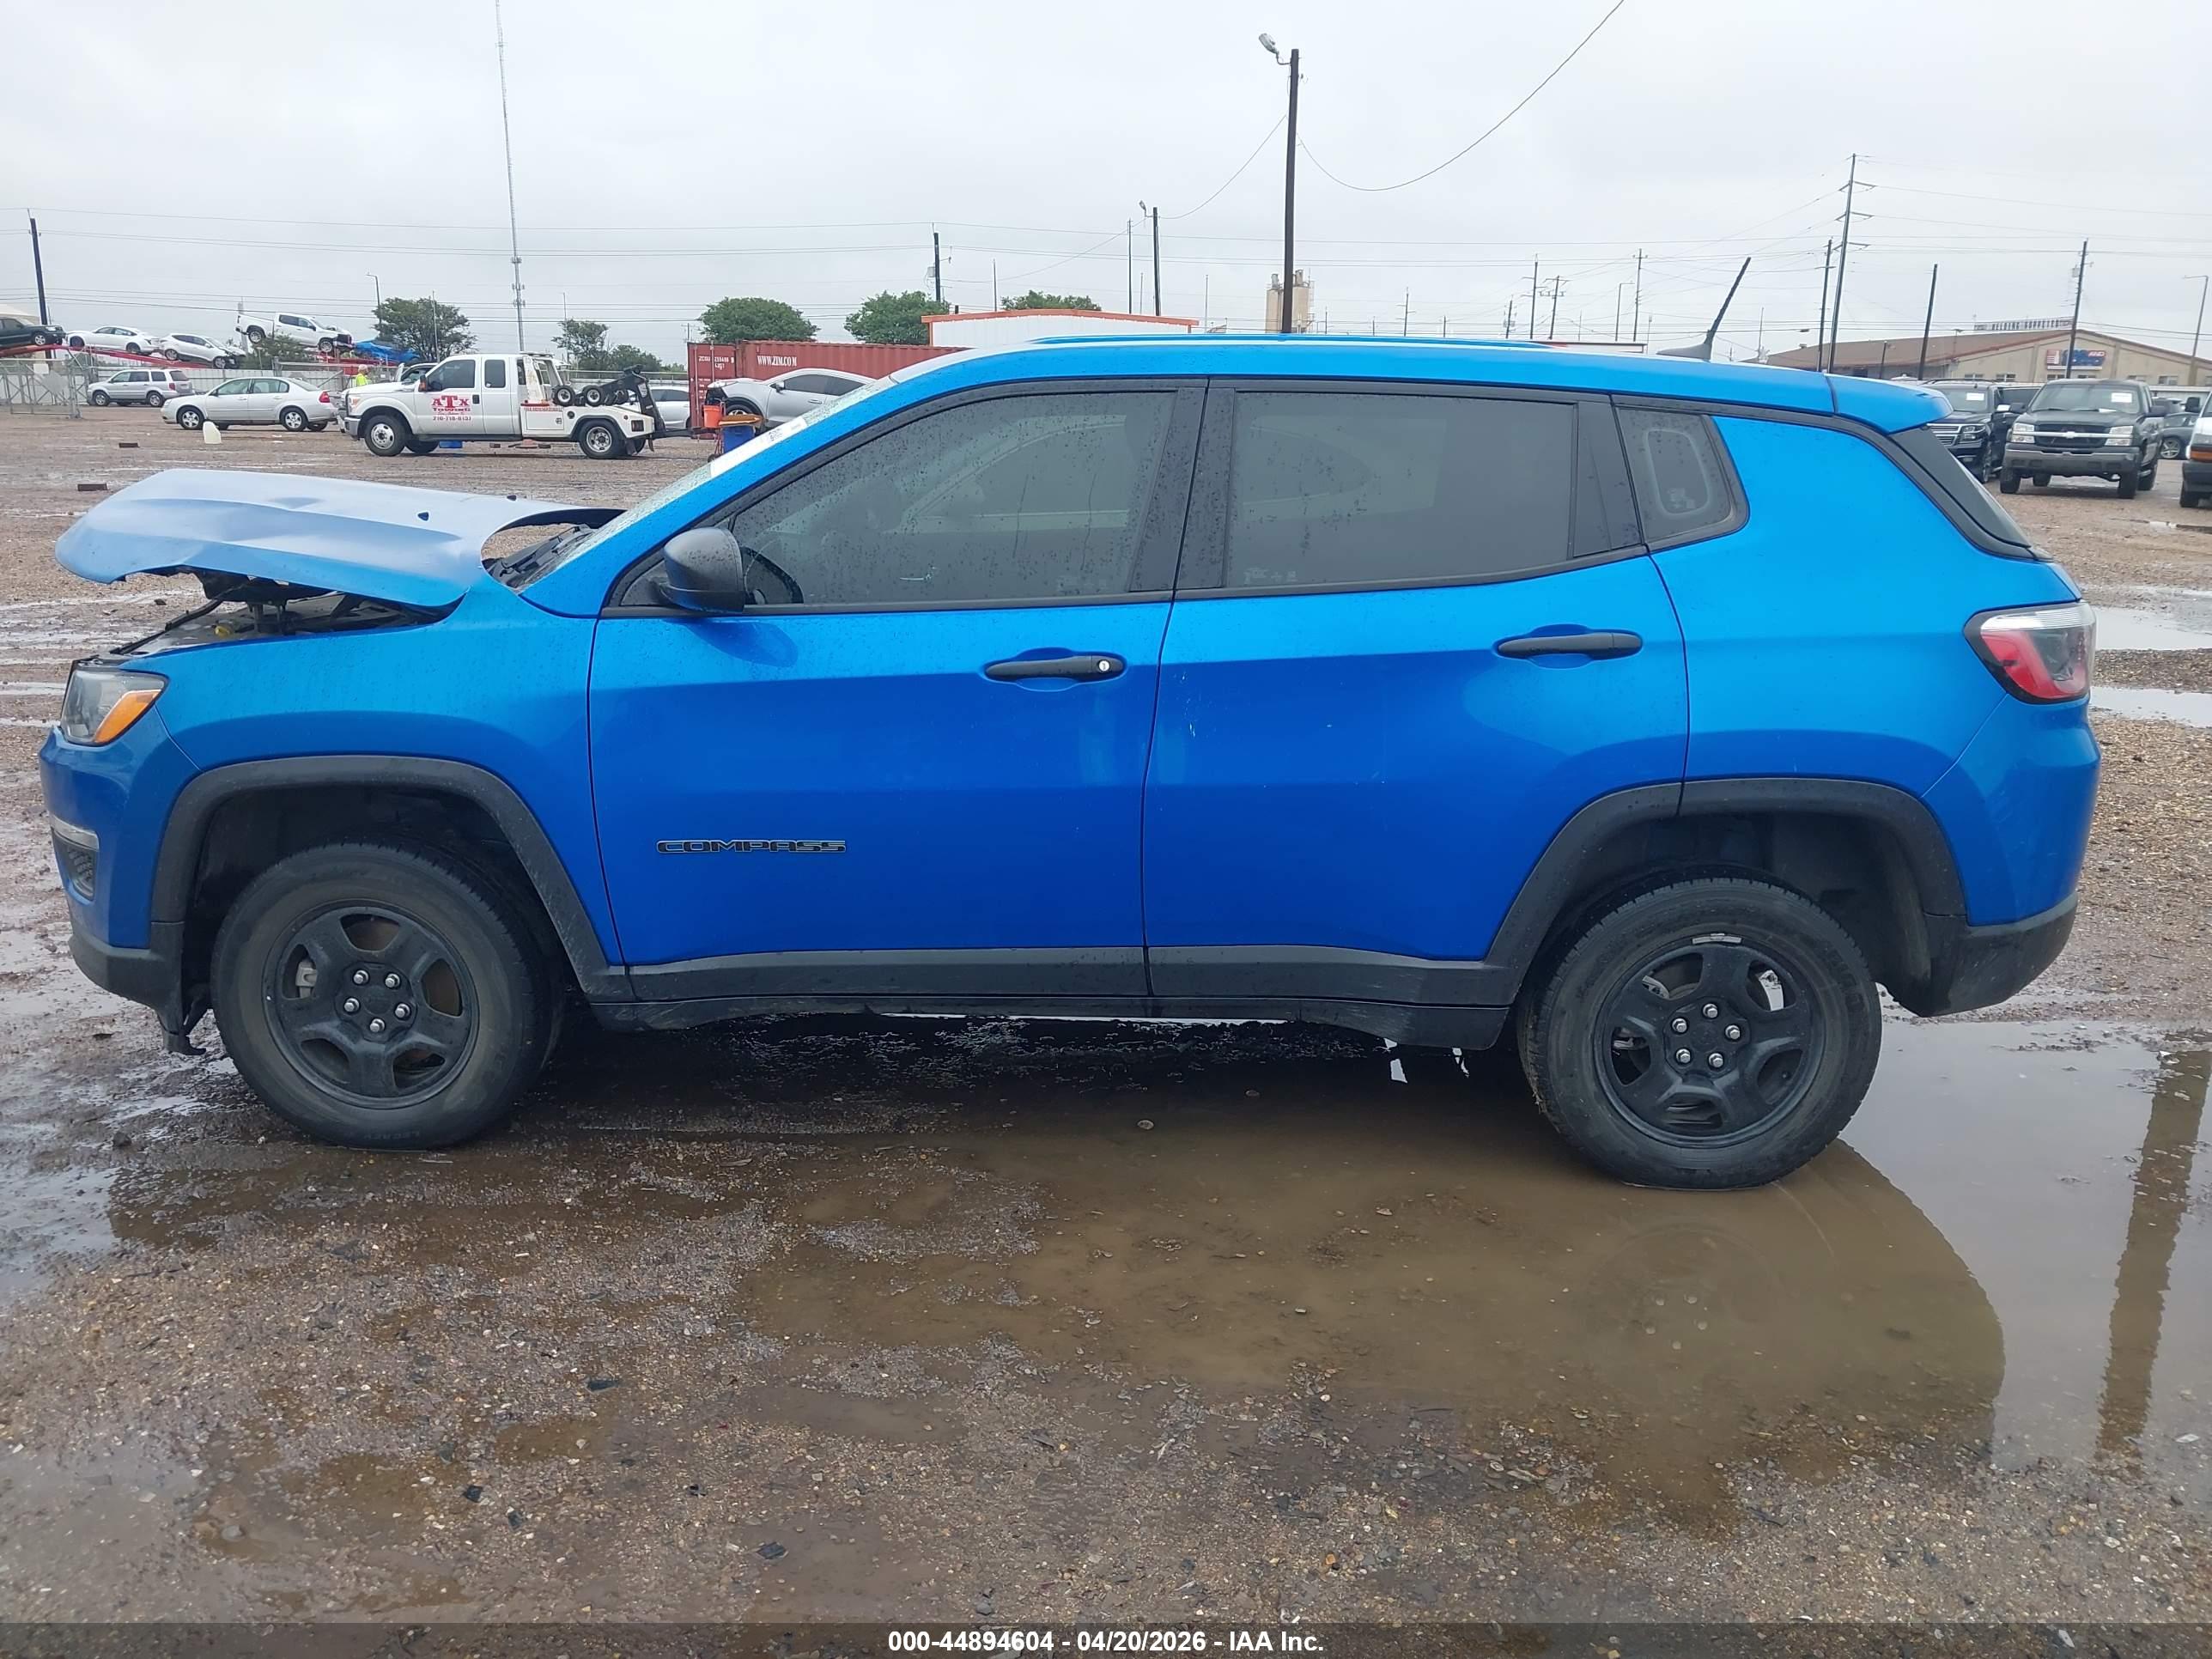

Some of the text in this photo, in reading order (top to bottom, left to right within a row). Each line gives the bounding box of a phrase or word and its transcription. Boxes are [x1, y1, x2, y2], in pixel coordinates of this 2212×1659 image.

[757, 355, 797, 367] WWW.ZIM.COM
[431, 395, 469, 408] ATX
[657, 839, 846, 853] COMPASS
